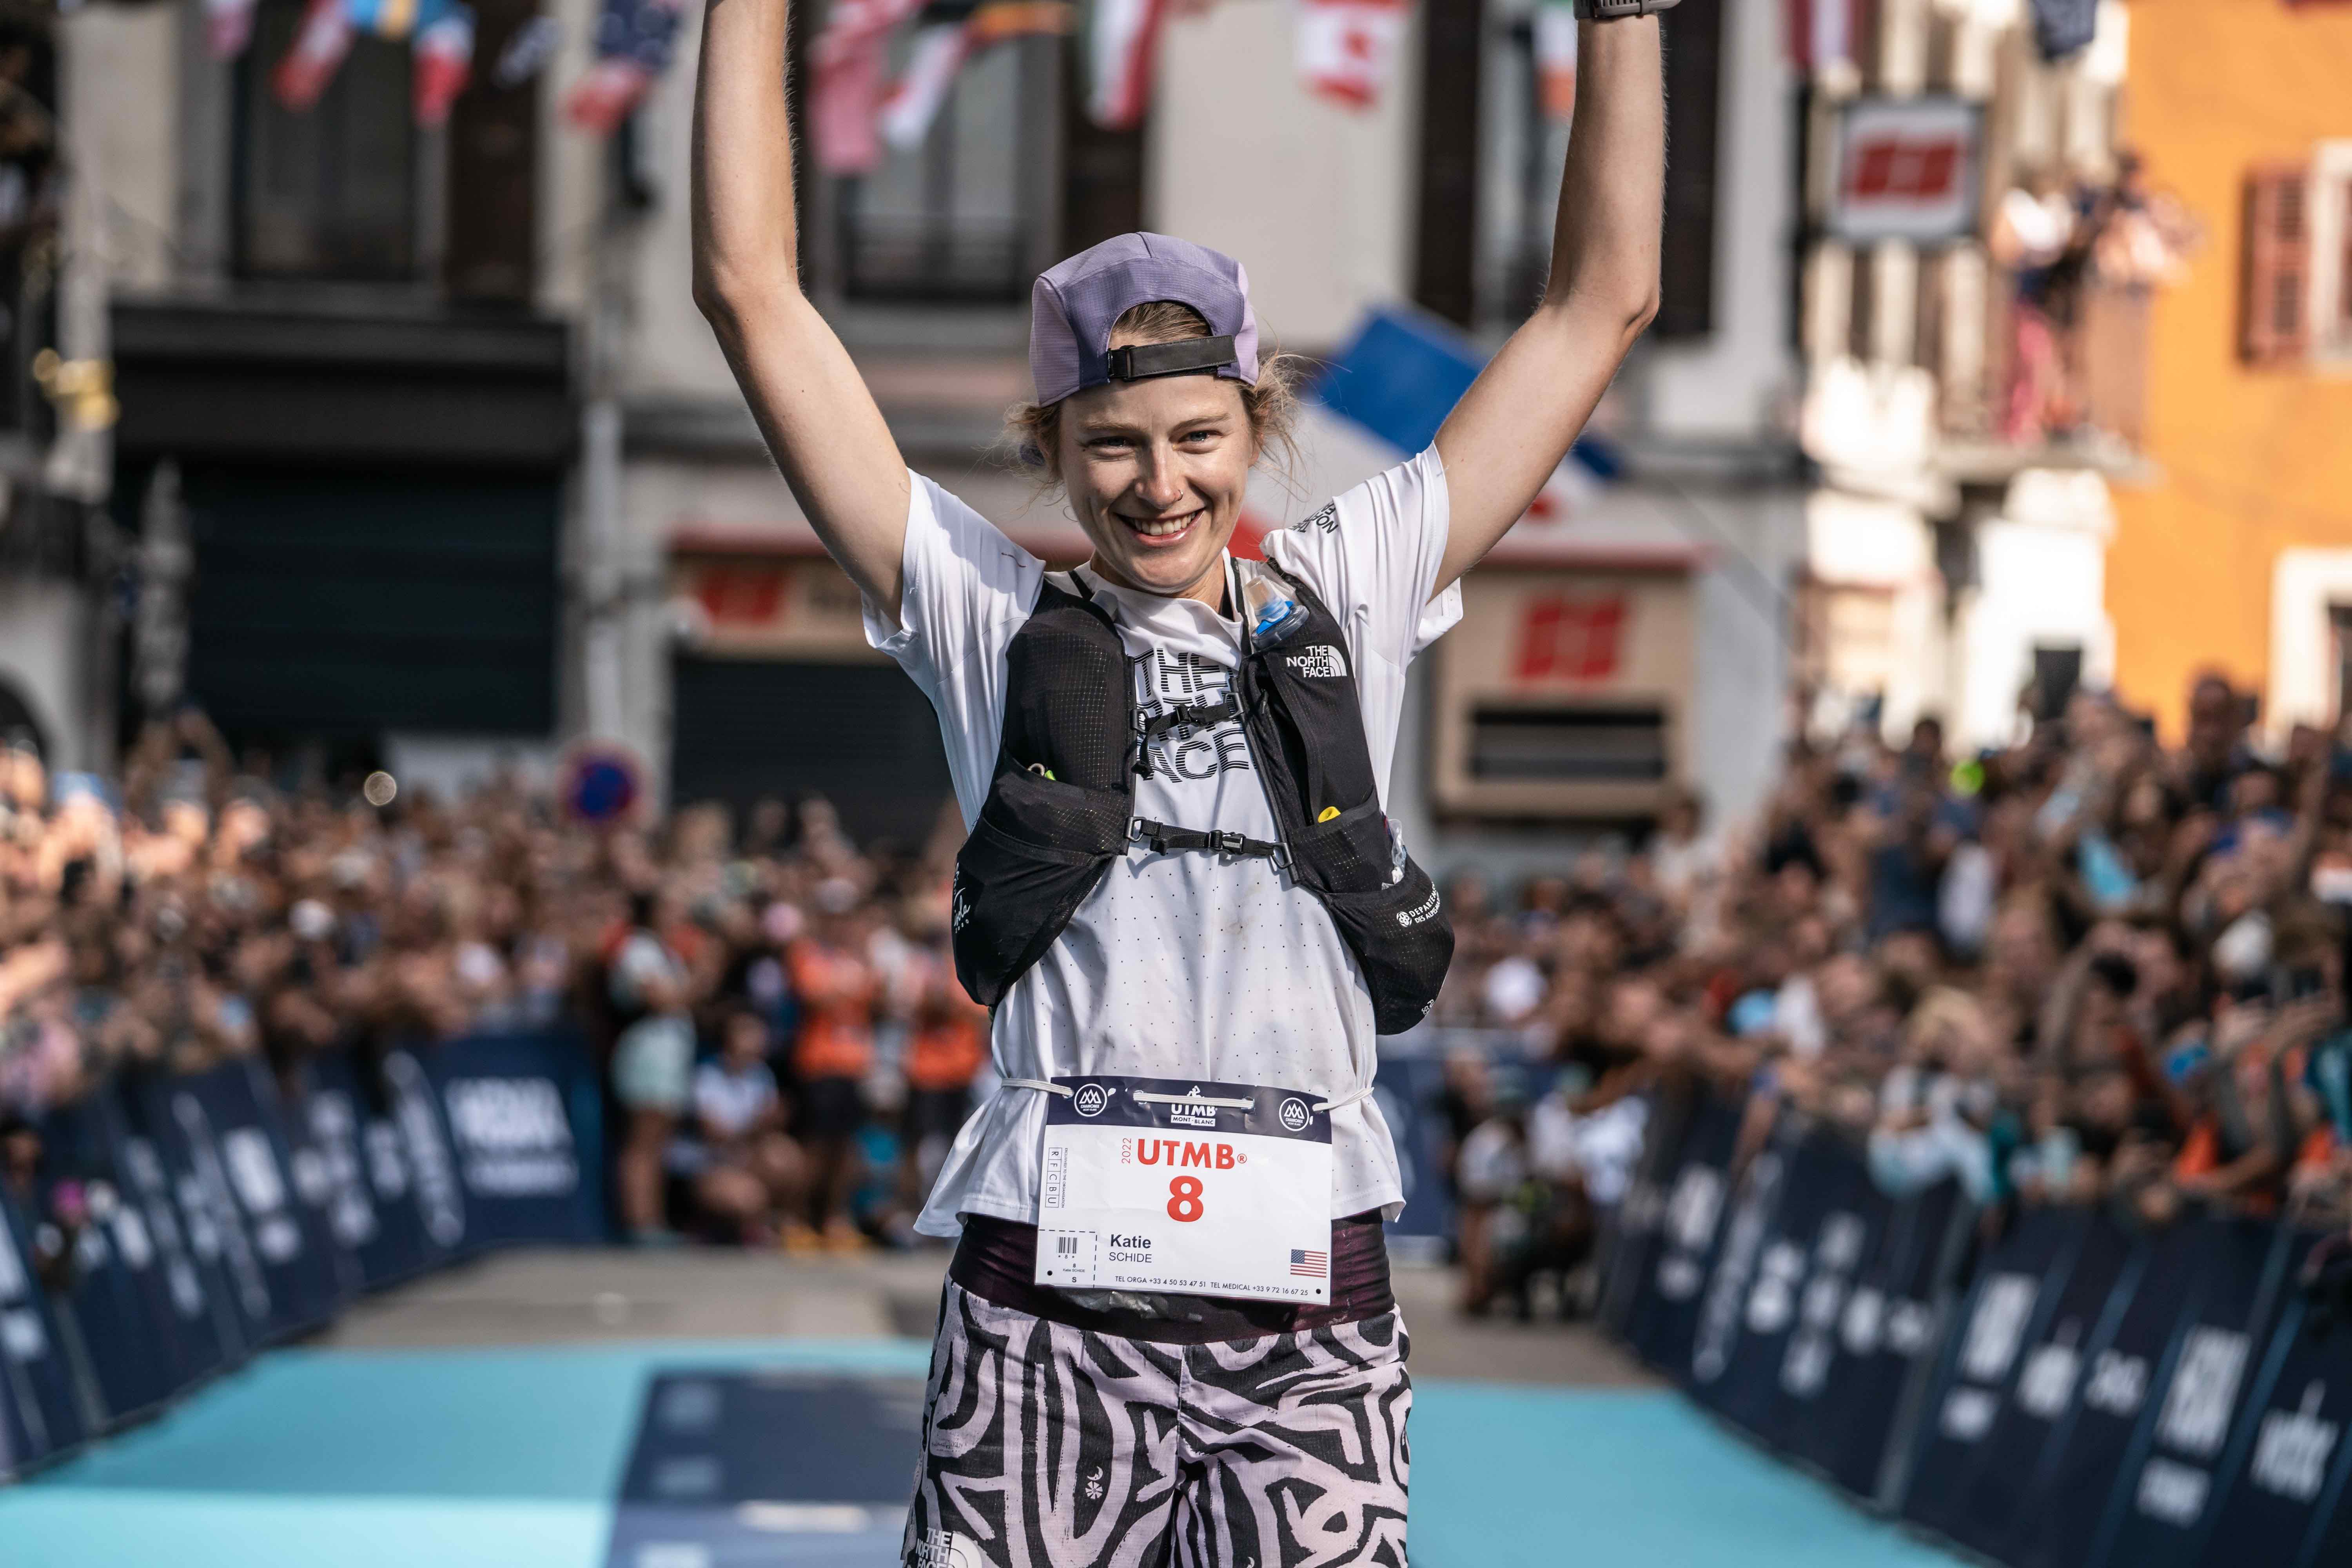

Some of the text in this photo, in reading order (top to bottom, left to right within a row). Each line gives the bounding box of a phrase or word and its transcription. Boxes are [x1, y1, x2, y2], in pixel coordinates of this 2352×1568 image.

[1305, 646, 1328, 656] THE
[1286, 656, 1328, 667] NORTH
[1134, 648, 1228, 697] THE
[1303, 667, 1330, 677] FACE
[1137, 728, 1249, 783] ACE
[1414, 915, 1426, 923] DES
[1122, 1138, 1132, 1163] 2022
[1167, 1175, 1203, 1222] 8
[1111, 1234, 1151, 1249] Katie
[1109, 1252, 1152, 1263] SCHIDE
[926, 1527, 952, 1547] THE
[916, 1538, 949, 1563] NORTH
